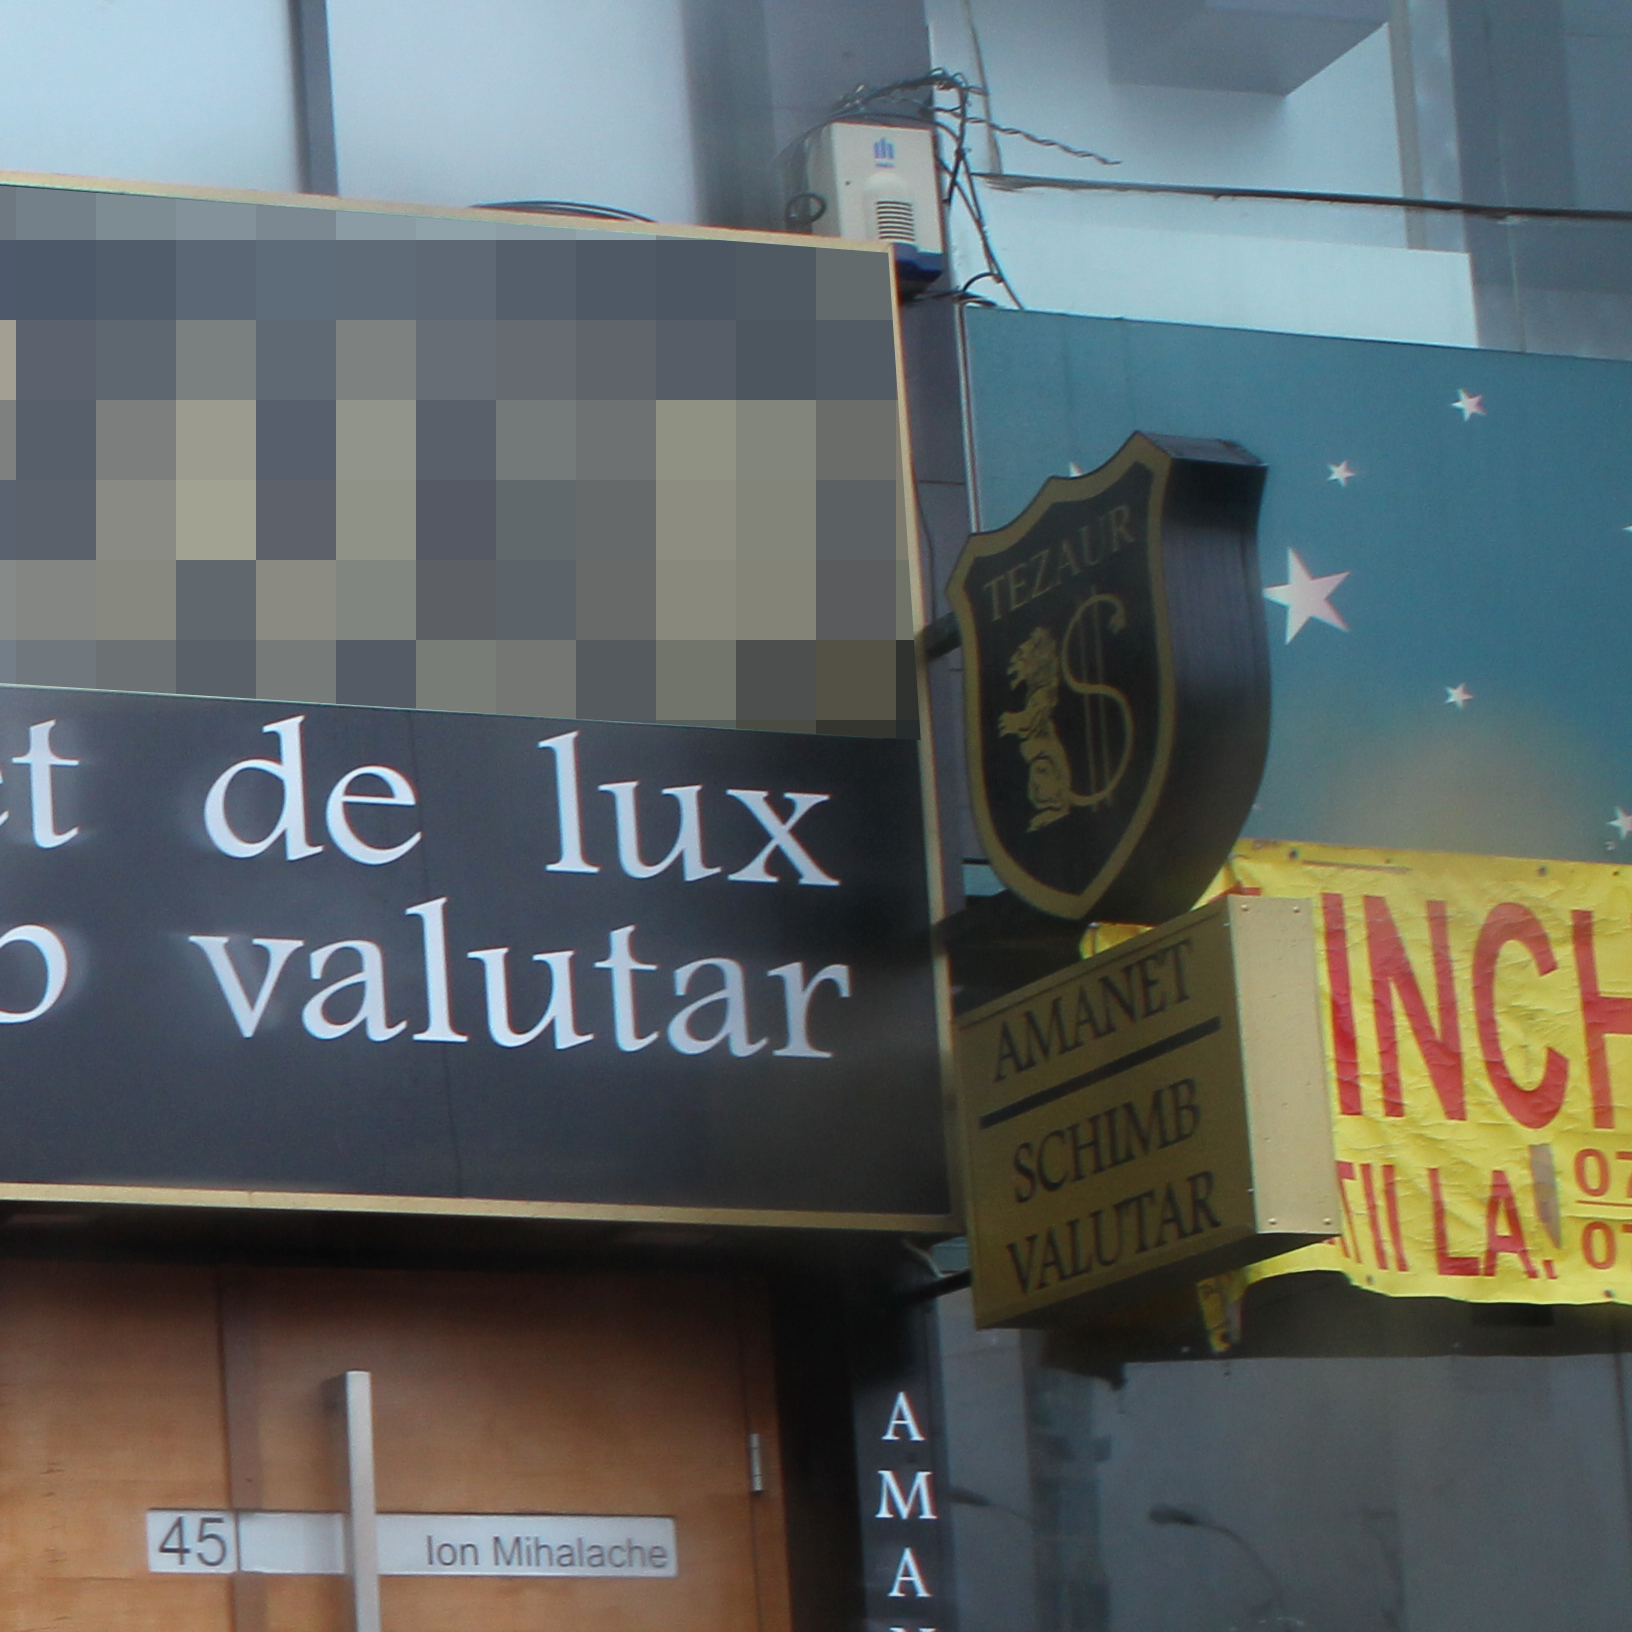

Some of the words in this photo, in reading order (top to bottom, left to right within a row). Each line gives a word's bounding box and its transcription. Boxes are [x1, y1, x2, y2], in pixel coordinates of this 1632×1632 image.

[984, 504, 1136, 622] TEZAUR
[204, 715, 422, 865] de
[538, 731, 840, 887] lux
[188, 897, 851, 1059] valutar
[993, 940, 1193, 1083] AMANET
[1012, 1078, 1201, 1203] SCHIMB
[1007, 1170, 1221, 1296] VALUTAR
[157, 1515, 229, 1567] 45
[426, 1534, 480, 1568] Ion
[493, 1534, 668, 1569] Mihalache
